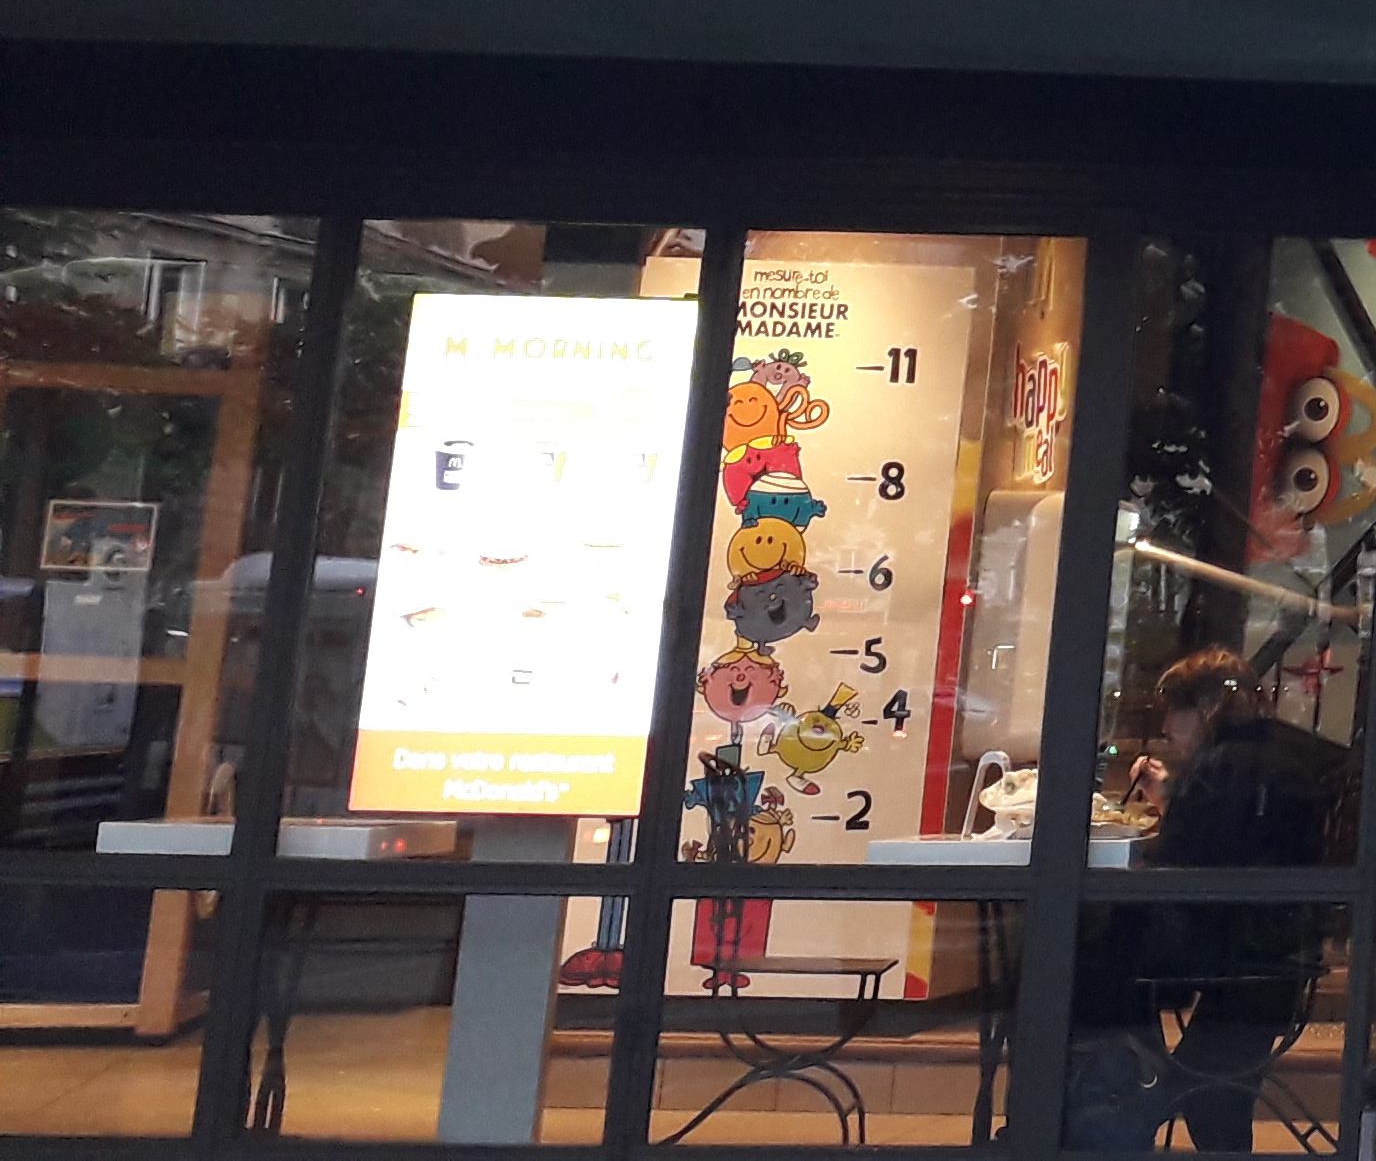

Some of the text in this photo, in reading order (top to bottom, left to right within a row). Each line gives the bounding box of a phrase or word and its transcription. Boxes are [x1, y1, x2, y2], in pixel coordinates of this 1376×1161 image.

[742, 283, 840, 301] en nombre de
[737, 320, 836, 338] MADAME
[887, 347, 918, 384] 11
[877, 461, 906, 501] 8
[869, 554, 894, 591] 6
[859, 637, 888, 674] 5
[883, 689, 911, 732] 4
[845, 790, 871, 830] 2
